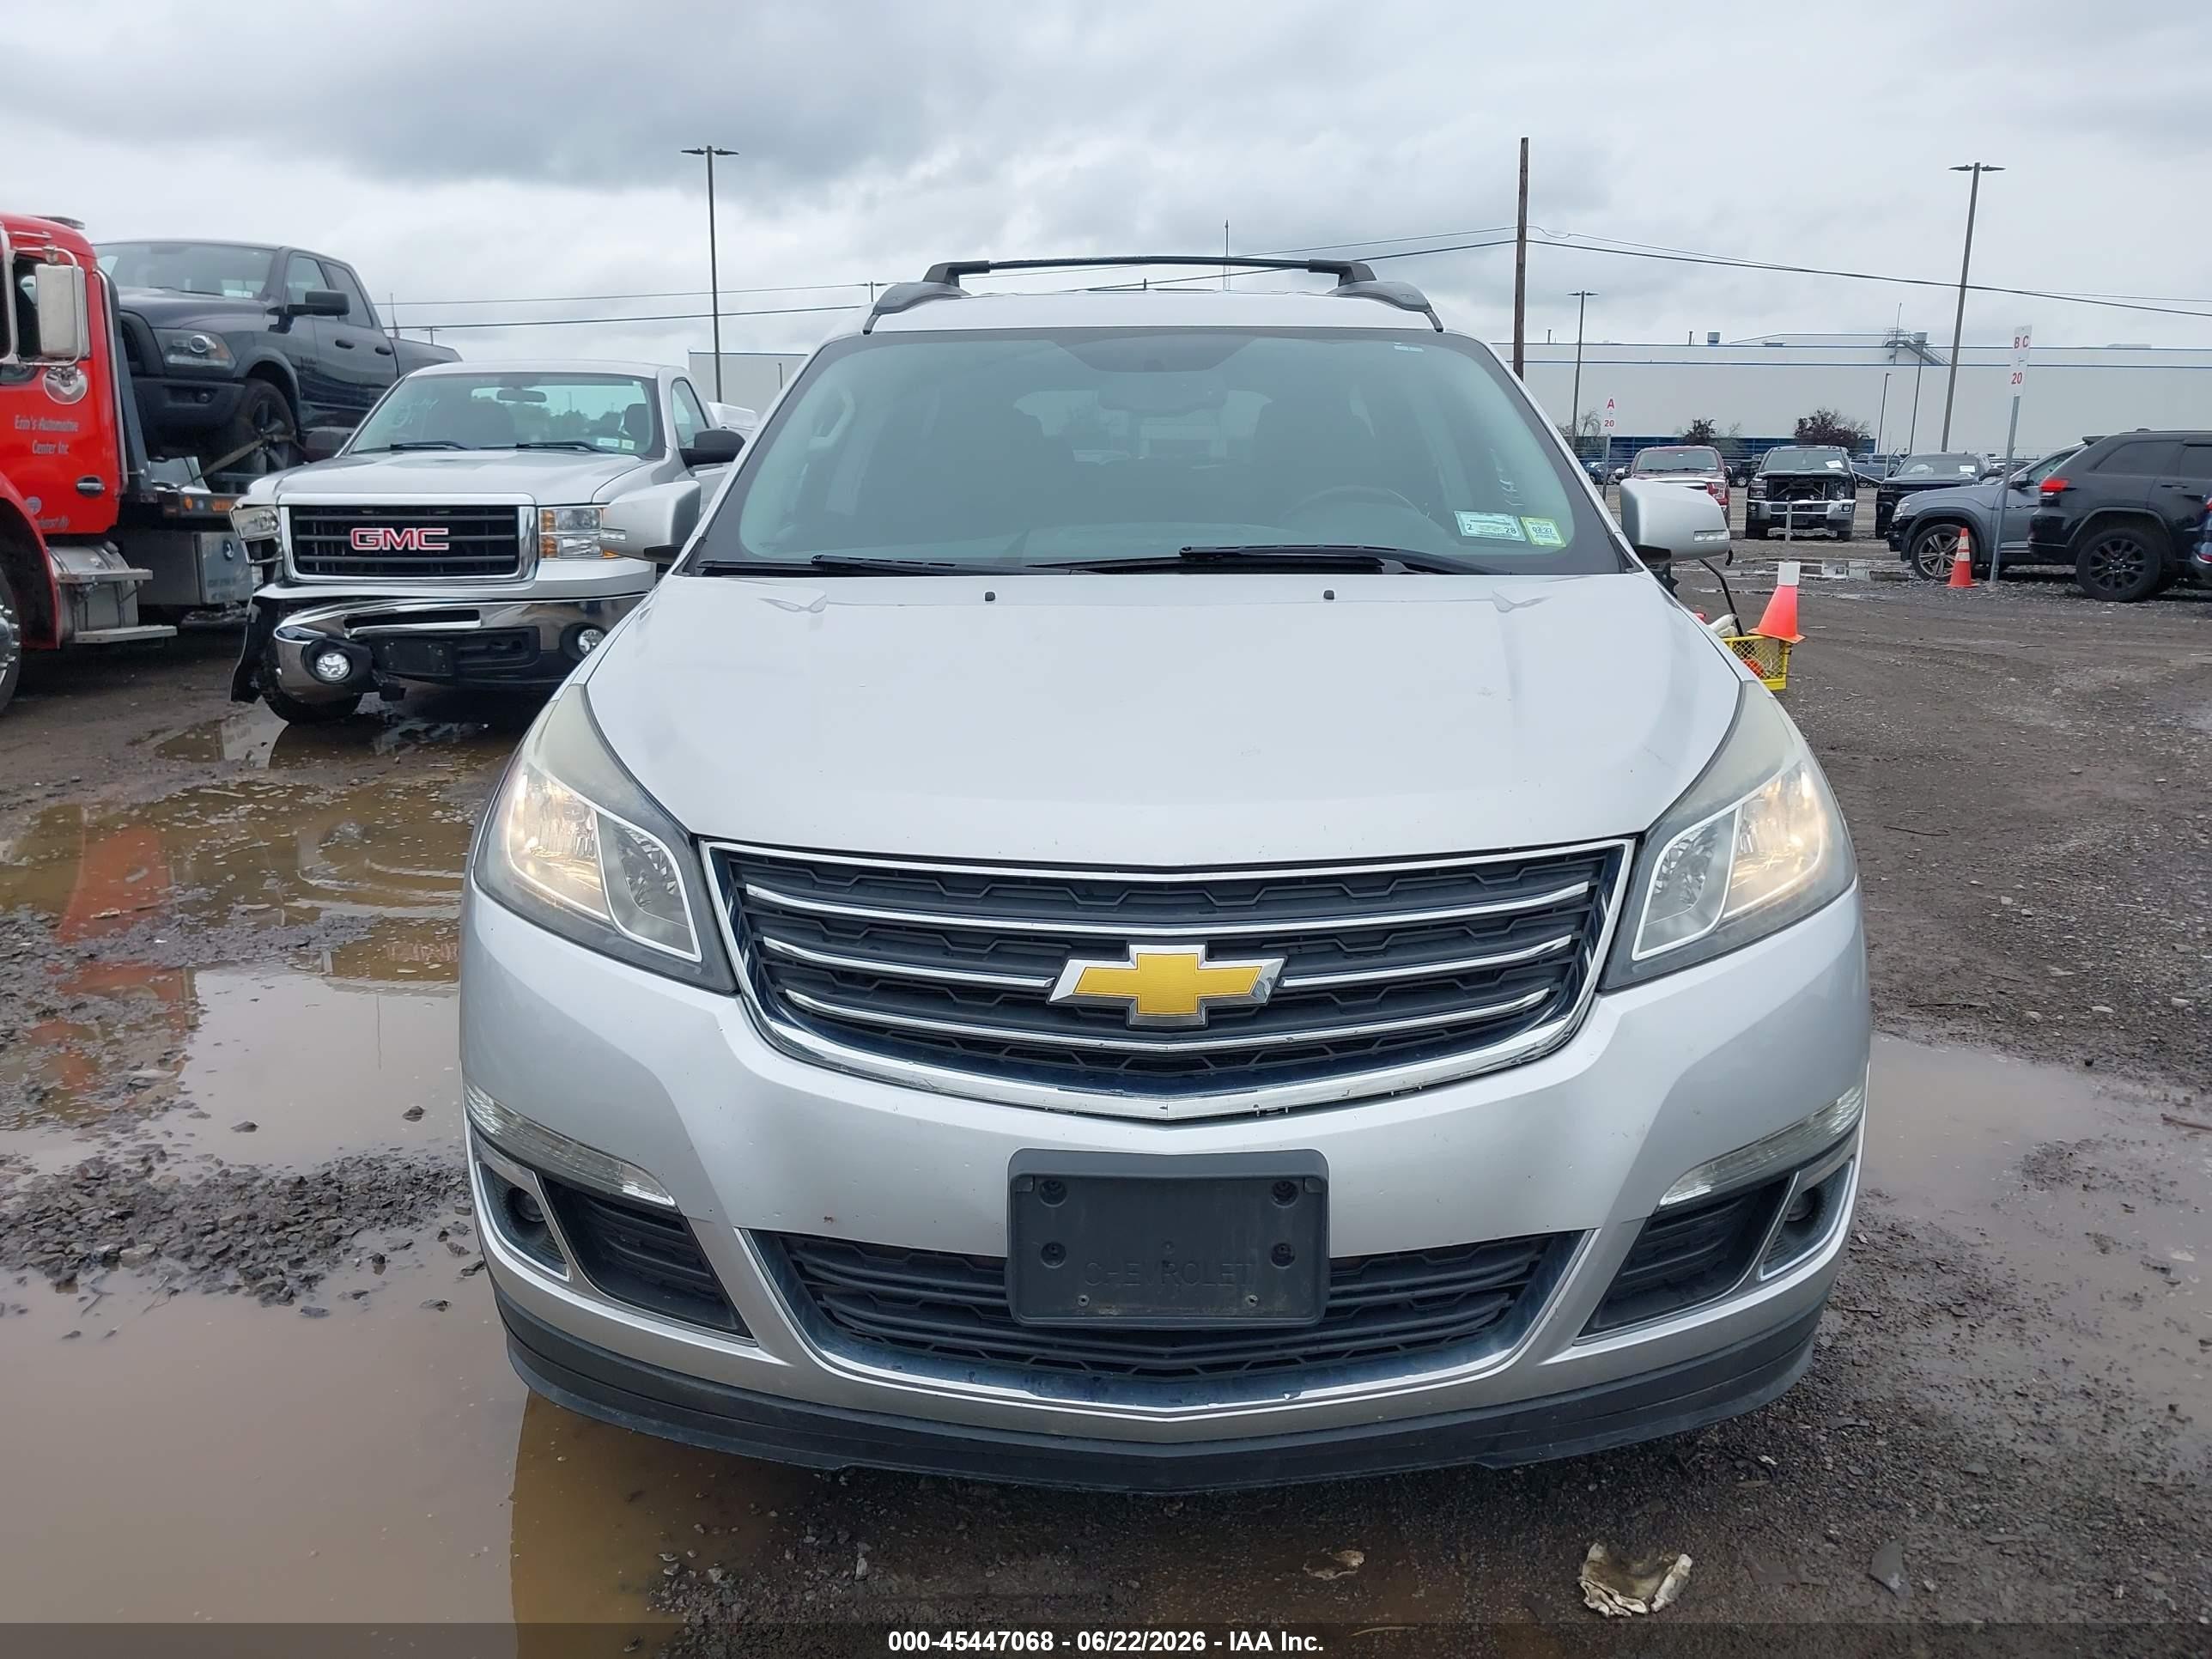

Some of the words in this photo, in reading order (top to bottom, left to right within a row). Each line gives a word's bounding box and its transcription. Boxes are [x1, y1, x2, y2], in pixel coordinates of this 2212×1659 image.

[2014, 337, 2021, 349] B
[2022, 335, 2029, 348] C
[2011, 372, 2023, 385] 20
[1607, 398, 1614, 409] A
[32, 440, 56, 454] Center
[350, 527, 449, 550] GMC
[1085, 1259, 1253, 1286] CHEVROLET
